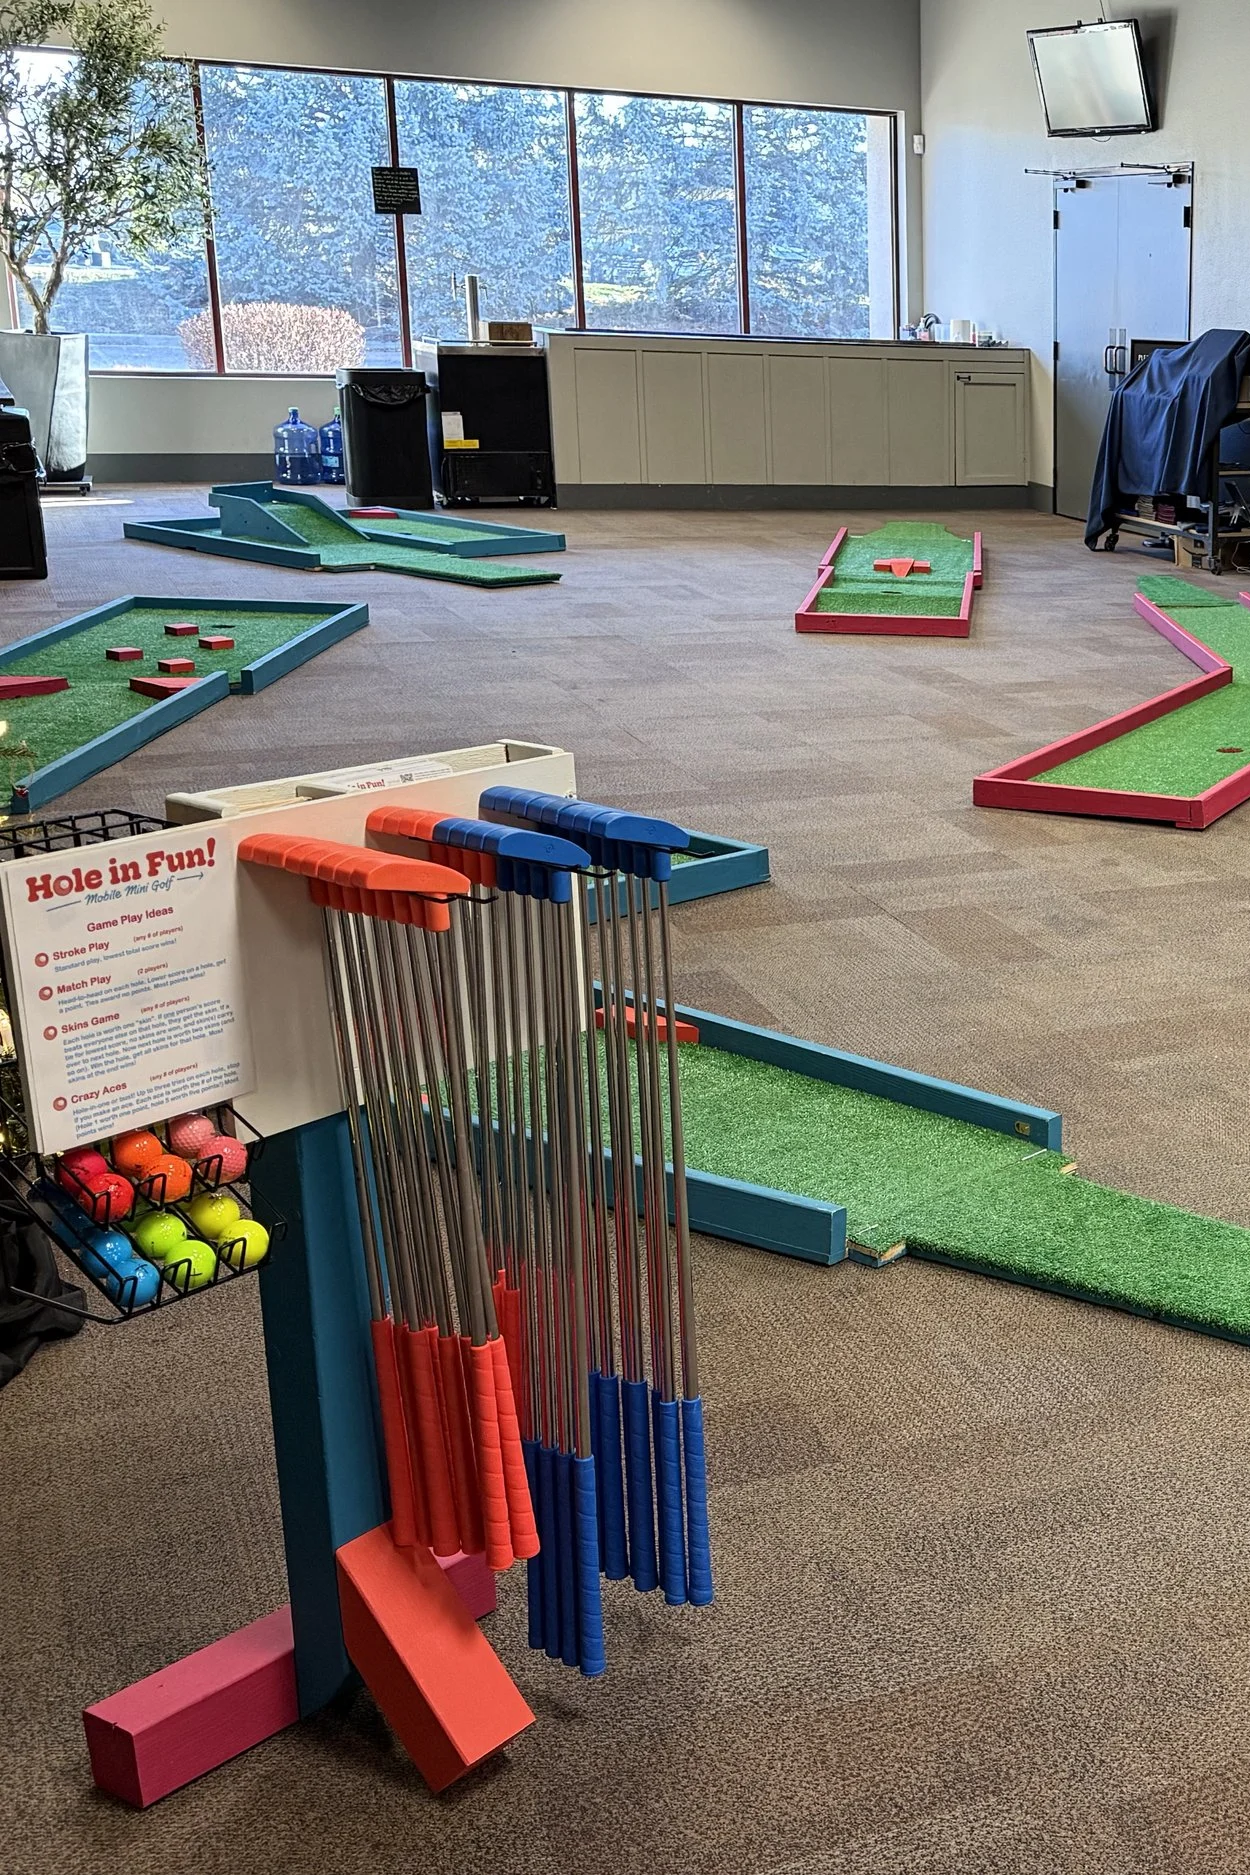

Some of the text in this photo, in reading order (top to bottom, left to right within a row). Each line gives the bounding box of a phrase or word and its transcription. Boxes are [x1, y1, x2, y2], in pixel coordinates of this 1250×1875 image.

[26, 838, 215, 902] Hole in Fun!
[85, 875, 175, 905] Mobile Mini Golf
[87, 907, 173, 932] Game Play Ideas
[53, 942, 109, 960] Stroke Play
[57, 976, 111, 994] Match Play
[61, 1014, 119, 1033] Skins Game
[71, 1083, 127, 1103] Crazy Aces
